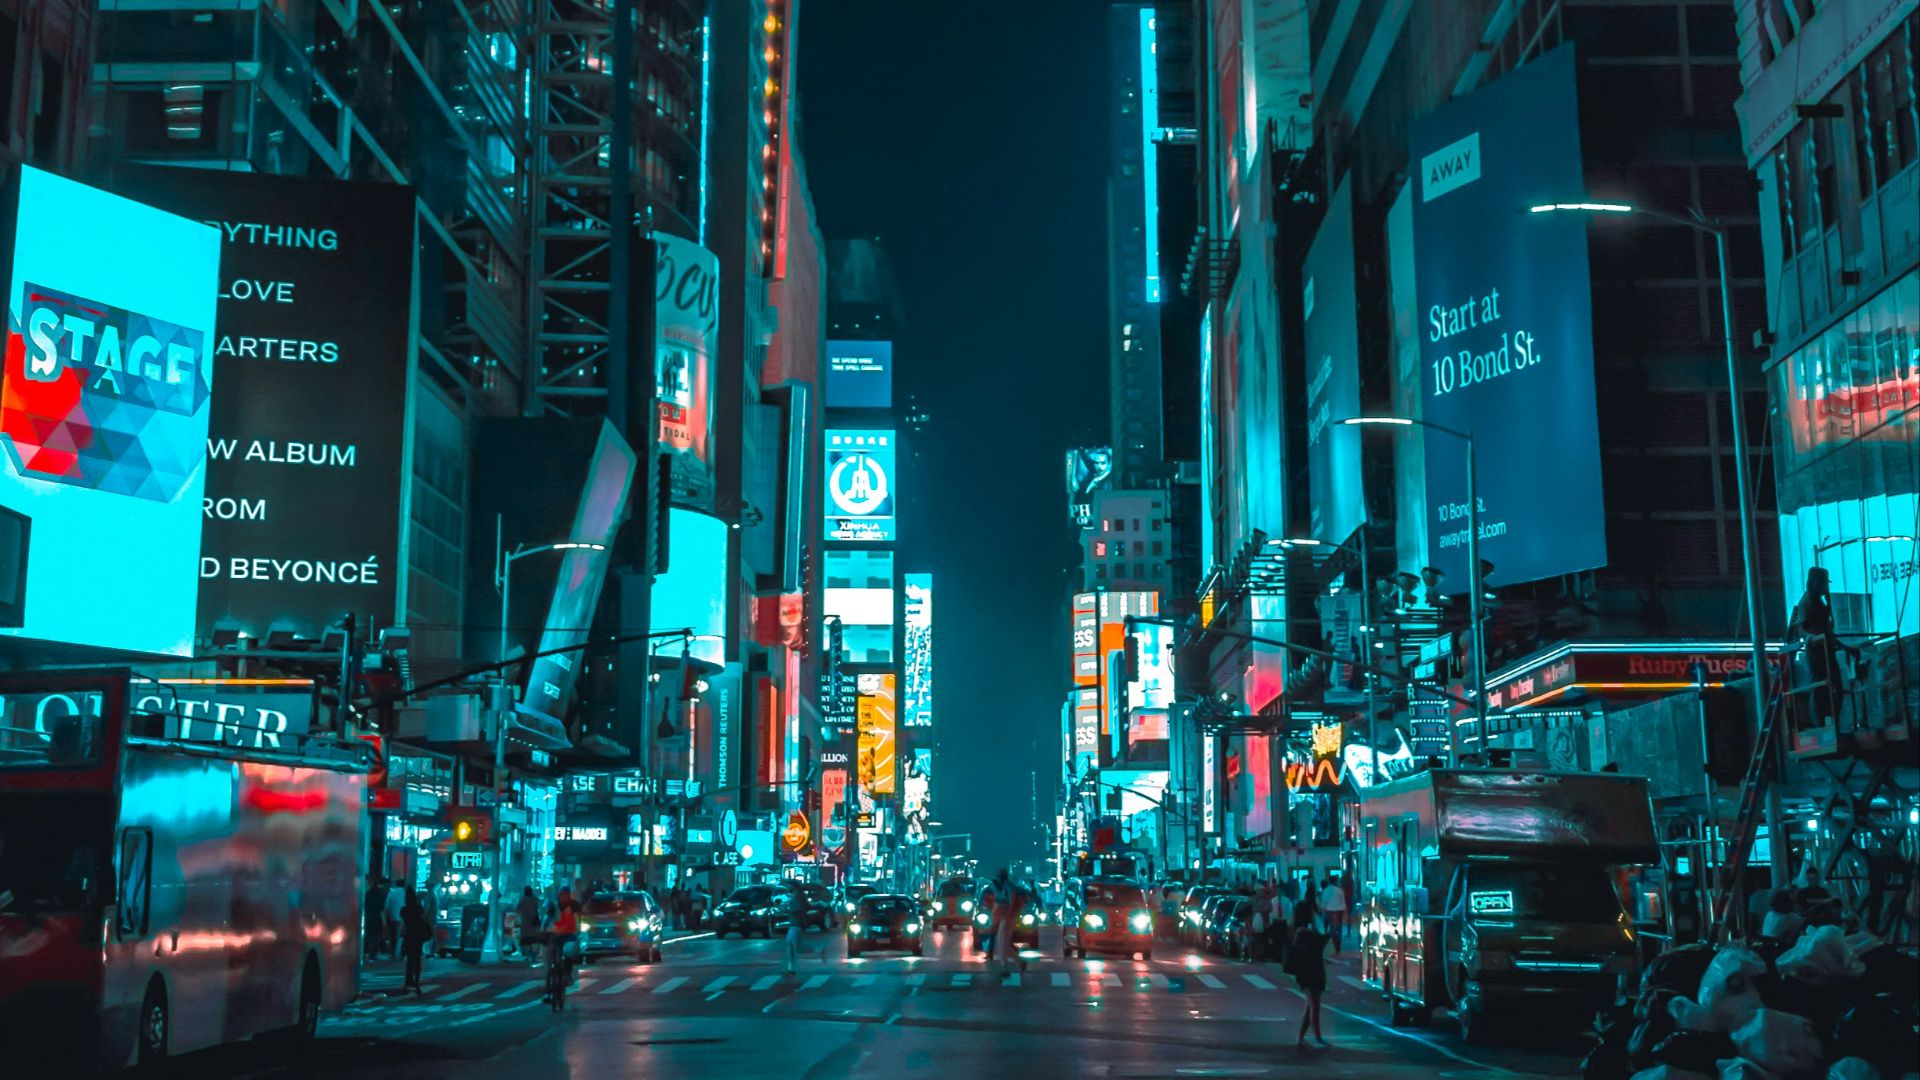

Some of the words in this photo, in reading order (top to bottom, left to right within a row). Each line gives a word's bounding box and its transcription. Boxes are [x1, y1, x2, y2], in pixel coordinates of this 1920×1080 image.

[1431, 150, 1471, 186] AWAY
[1429, 295, 1477, 342] Start
[1481, 287, 1501, 323] at
[215, 335, 338, 363] ARTERS
[1432, 356, 1455, 396] 10
[1458, 332, 1511, 388] Bond
[1514, 330, 1541, 370] St.
[244, 440, 357, 467] ALBUM
[230, 555, 379, 584] BEYONCÉ
[719, 688, 729, 734] REUTERS
[718, 736, 728, 788] THOMSON
